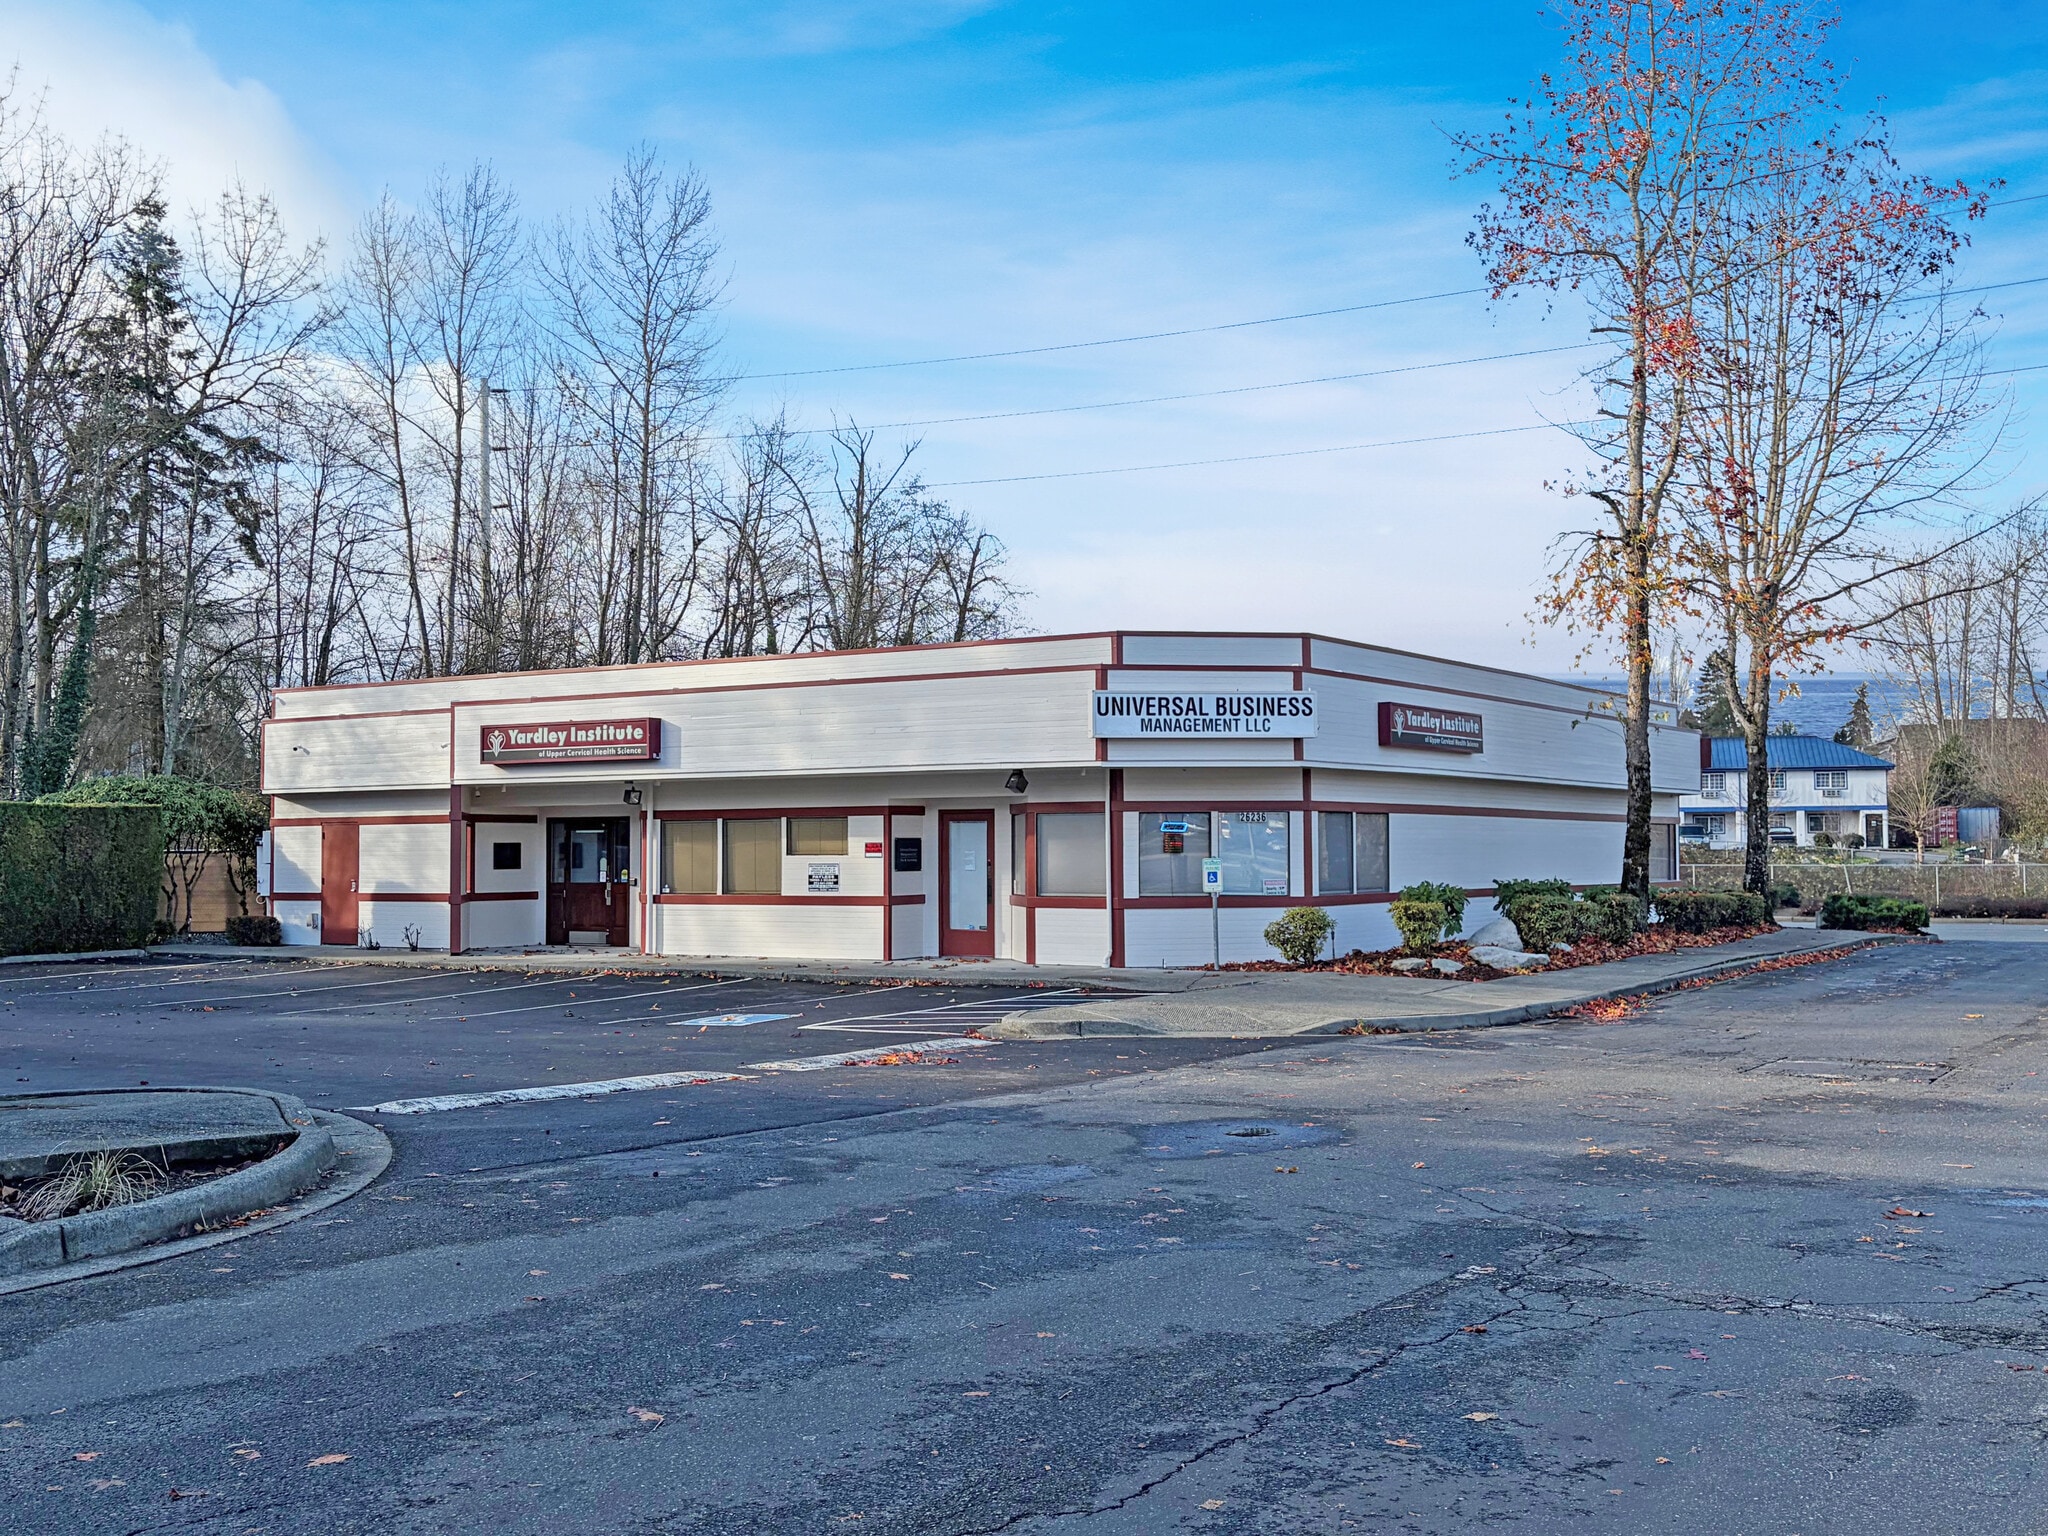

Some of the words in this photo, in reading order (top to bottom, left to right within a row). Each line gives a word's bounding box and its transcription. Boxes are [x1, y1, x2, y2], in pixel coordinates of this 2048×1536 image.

[1096, 696, 1209, 717] UNIVERSAL
[1215, 696, 1313, 717] BUSINESS
[1140, 718, 1241, 733] MANAGEMENT
[1245, 718, 1272, 733] LLC
[1406, 710, 1440, 732] Yardley
[1442, 715, 1479, 733] Institute
[508, 727, 568, 747] Yardley
[571, 724, 643, 742] Institute
[538, 750, 545, 758] of
[546, 750, 566, 759] Upper
[567, 749, 593, 757] Cervical
[594, 748, 616, 756] Health
[617, 747, 642, 755] Science
[1240, 812, 1266, 822] 26236
